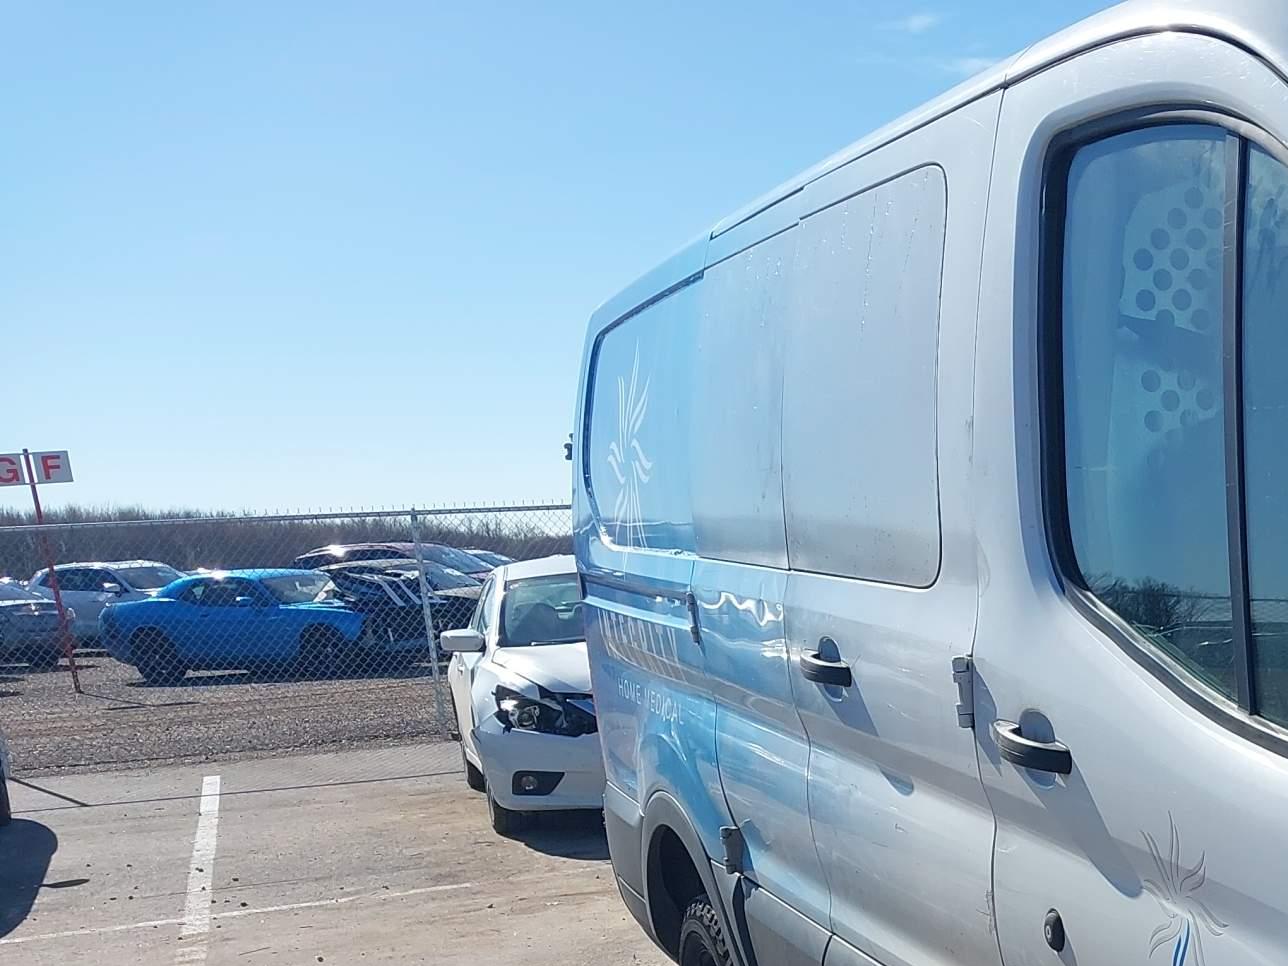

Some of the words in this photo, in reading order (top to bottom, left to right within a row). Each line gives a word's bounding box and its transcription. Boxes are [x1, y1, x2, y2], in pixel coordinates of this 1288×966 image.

[0, 456, 20, 483] G
[41, 454, 60, 480] F
[617, 677, 641, 705] HOME
[644, 687, 684, 725] MEDICAL
